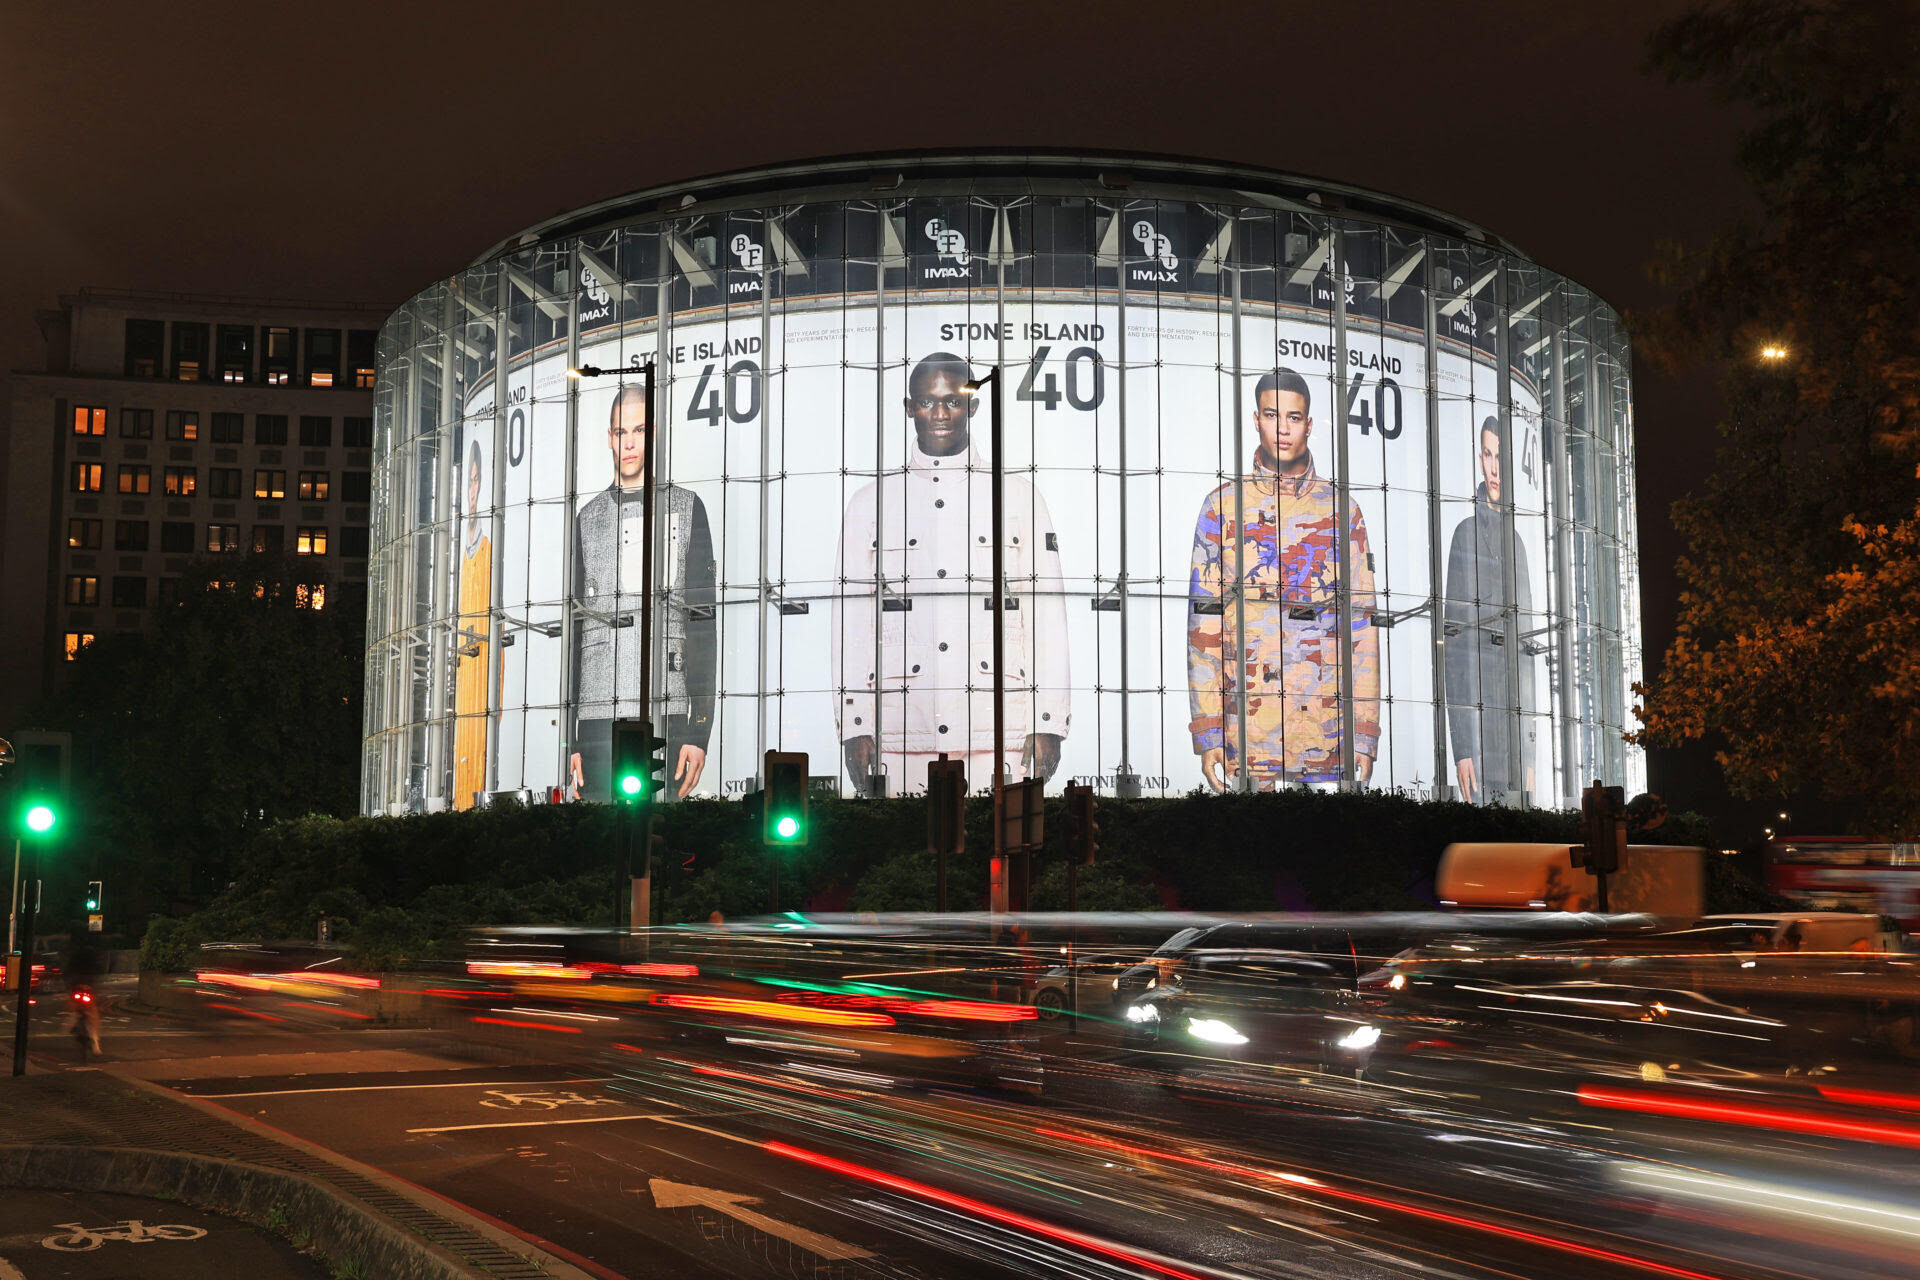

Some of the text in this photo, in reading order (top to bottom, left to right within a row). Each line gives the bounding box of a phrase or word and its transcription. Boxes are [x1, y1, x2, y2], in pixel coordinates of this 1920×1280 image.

[731, 234, 763, 272] BF
[925, 267, 972, 278] IMAX
[1133, 270, 1179, 282] IMAX
[730, 281, 763, 293] IMA
[1318, 289, 1355, 304] IMX
[580, 306, 609, 323] IMAX
[940, 323, 1104, 341] STONE ISLAND
[1453, 320, 1477, 338] IMAX
[693, 336, 762, 361] ISLAND
[1016, 346, 1104, 411] 40
[687, 359, 761, 427] 40
[1347, 372, 1403, 440] 40
